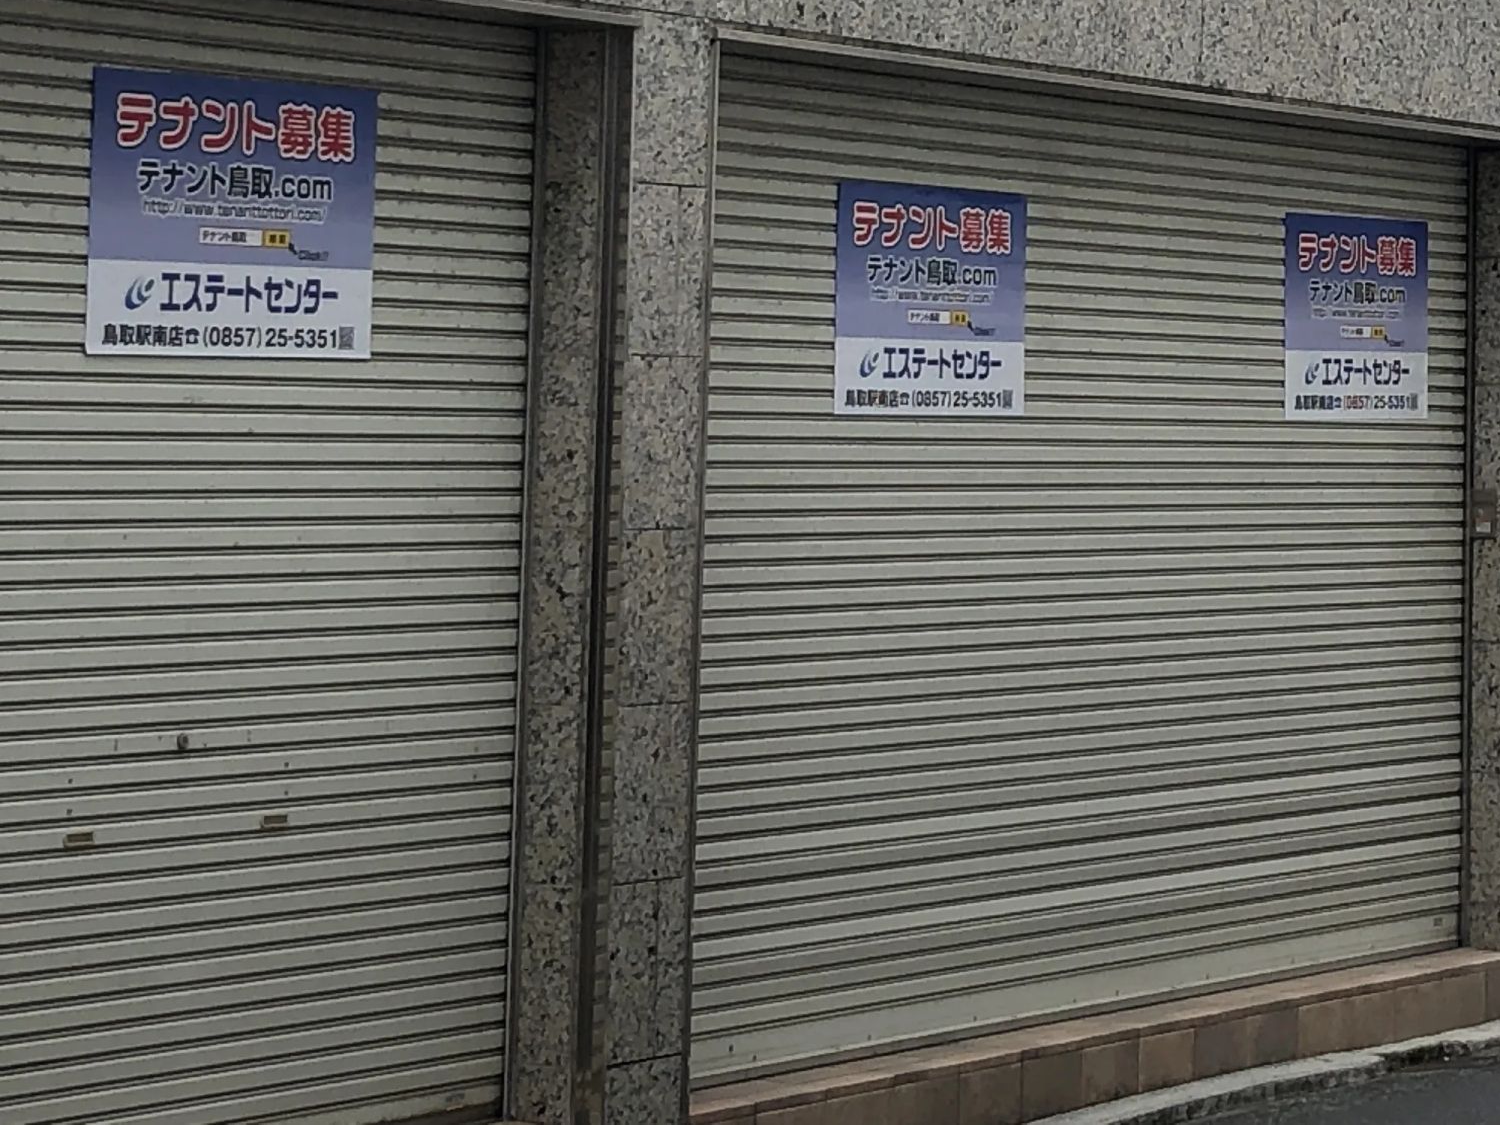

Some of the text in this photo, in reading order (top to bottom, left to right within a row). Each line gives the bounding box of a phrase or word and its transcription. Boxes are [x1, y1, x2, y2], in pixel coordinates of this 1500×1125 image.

[116, 92, 356, 163] テナント募集
[137, 160, 333, 202] テナント鳥取.com
[853, 201, 1013, 255] テナント募集
[867, 255, 999, 287] テナント鳥取.com
[1299, 233, 1417, 277] テナント募集
[160, 273, 339, 314] エステートセンター
[1309, 279, 1406, 305] テナント鳥取.com
[883, 346, 1002, 380] エステートセンター
[1322, 358, 1410, 386] エステートセンター
